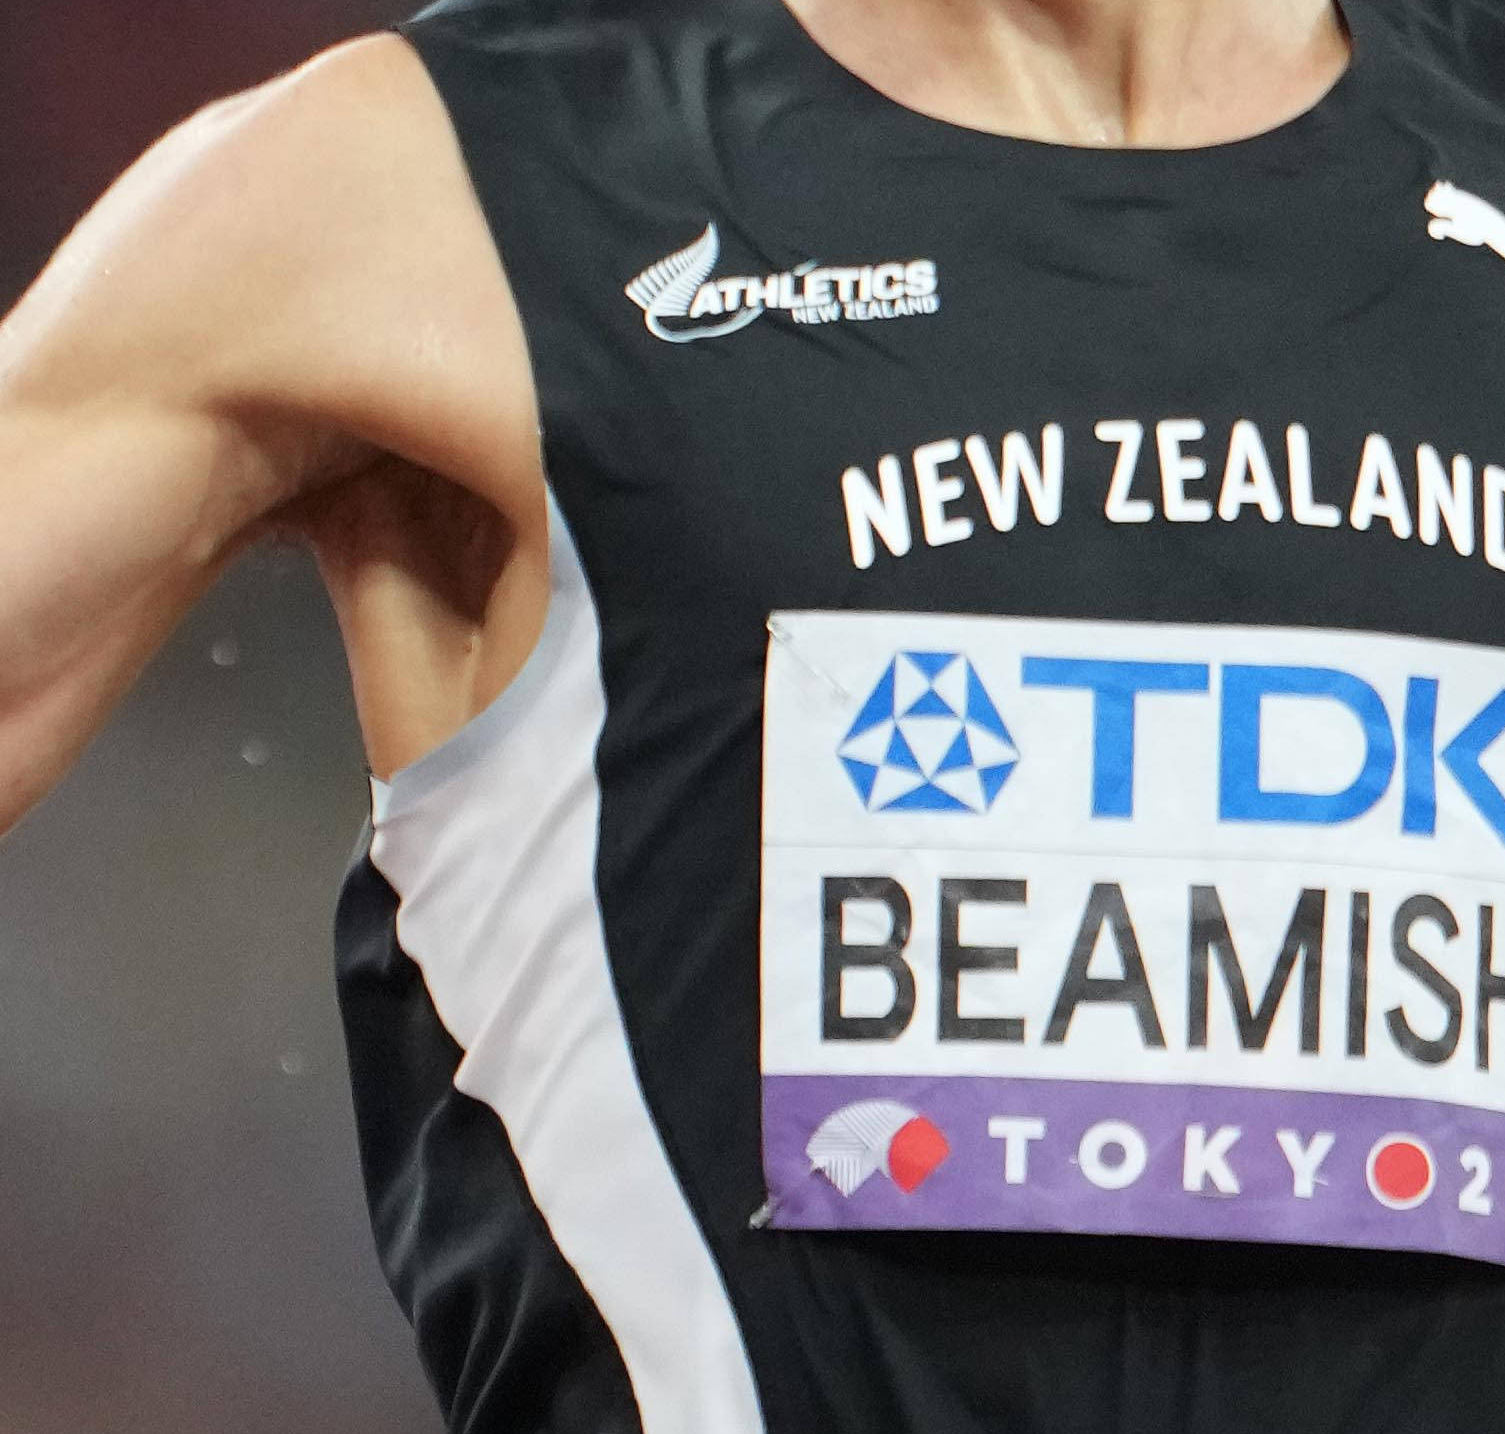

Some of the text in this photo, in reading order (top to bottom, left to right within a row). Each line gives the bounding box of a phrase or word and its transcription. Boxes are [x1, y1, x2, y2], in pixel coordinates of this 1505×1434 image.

[689, 259, 937, 318] ATHLETICS
[791, 293, 940, 324] NEW ZEALAND
[841, 421, 1065, 570] NEW
